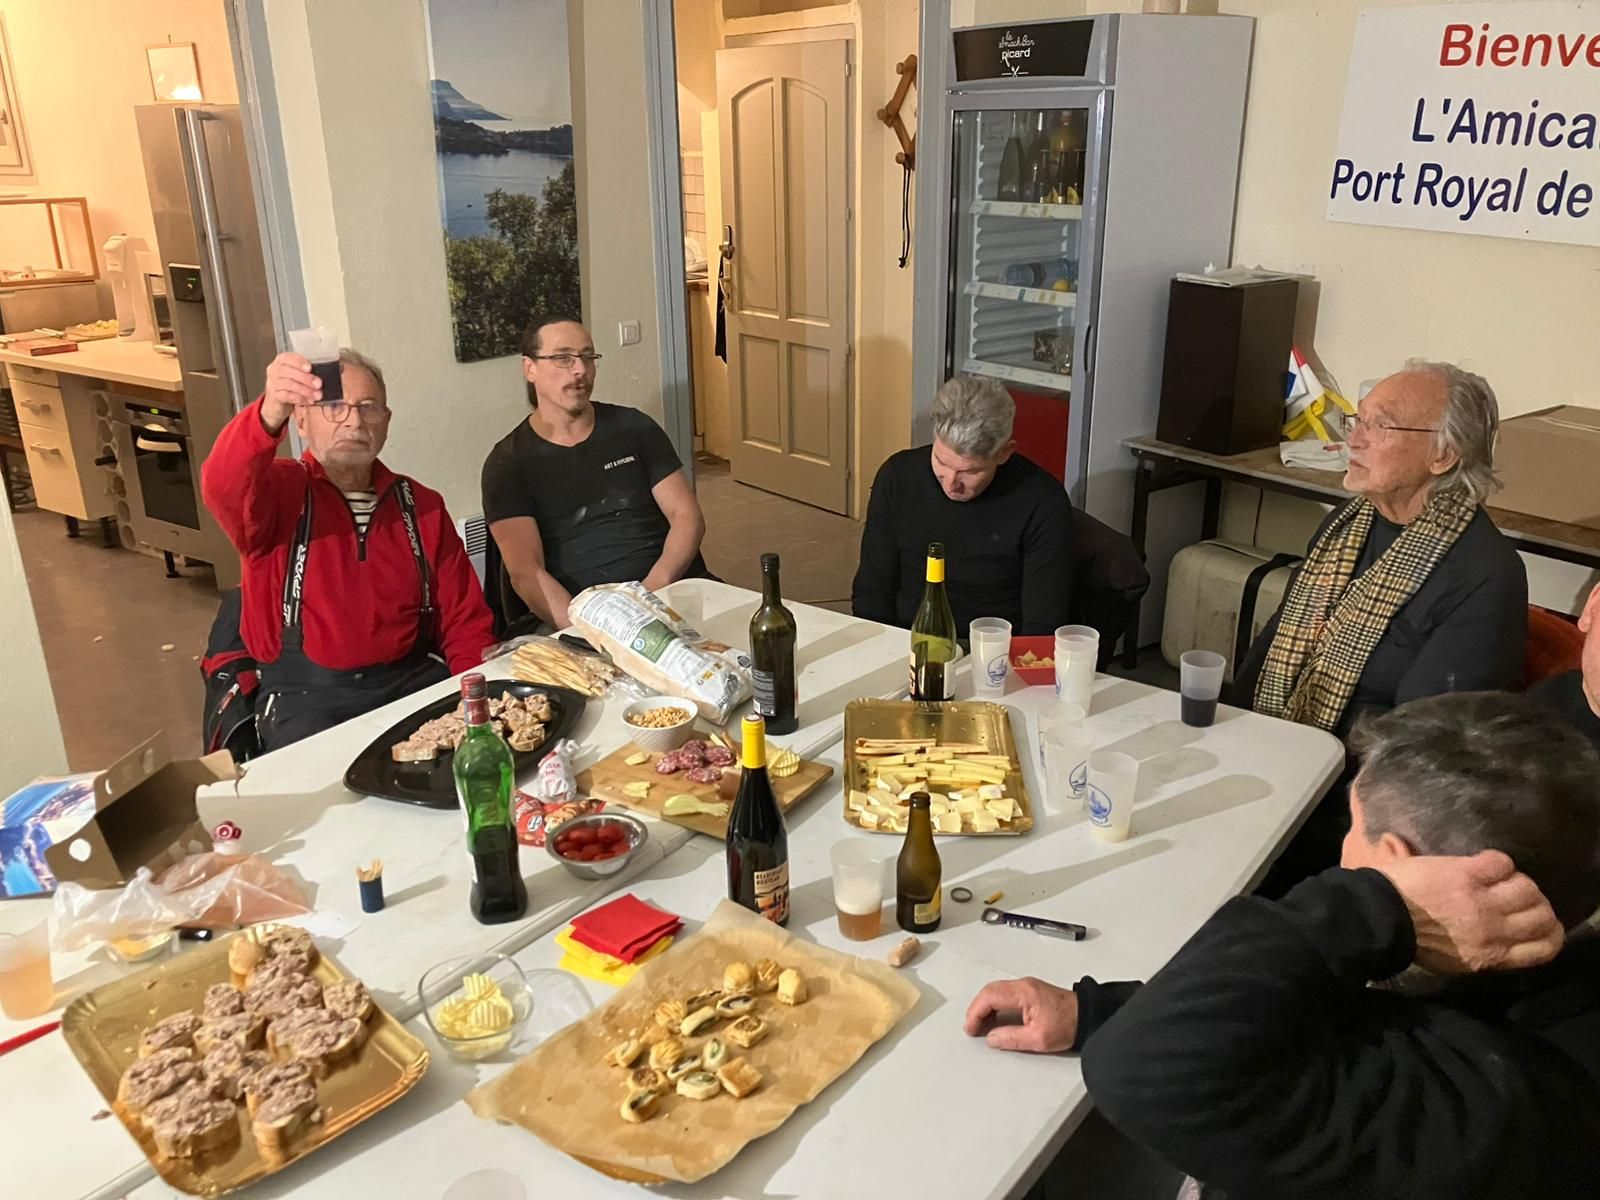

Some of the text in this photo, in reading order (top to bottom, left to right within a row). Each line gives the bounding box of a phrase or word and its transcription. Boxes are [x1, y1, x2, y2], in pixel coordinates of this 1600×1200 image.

[1412, 97, 1600, 149] L'Amica
[1330, 158, 1593, 221] Port Royal de
[292, 544, 307, 599] SPYDER
